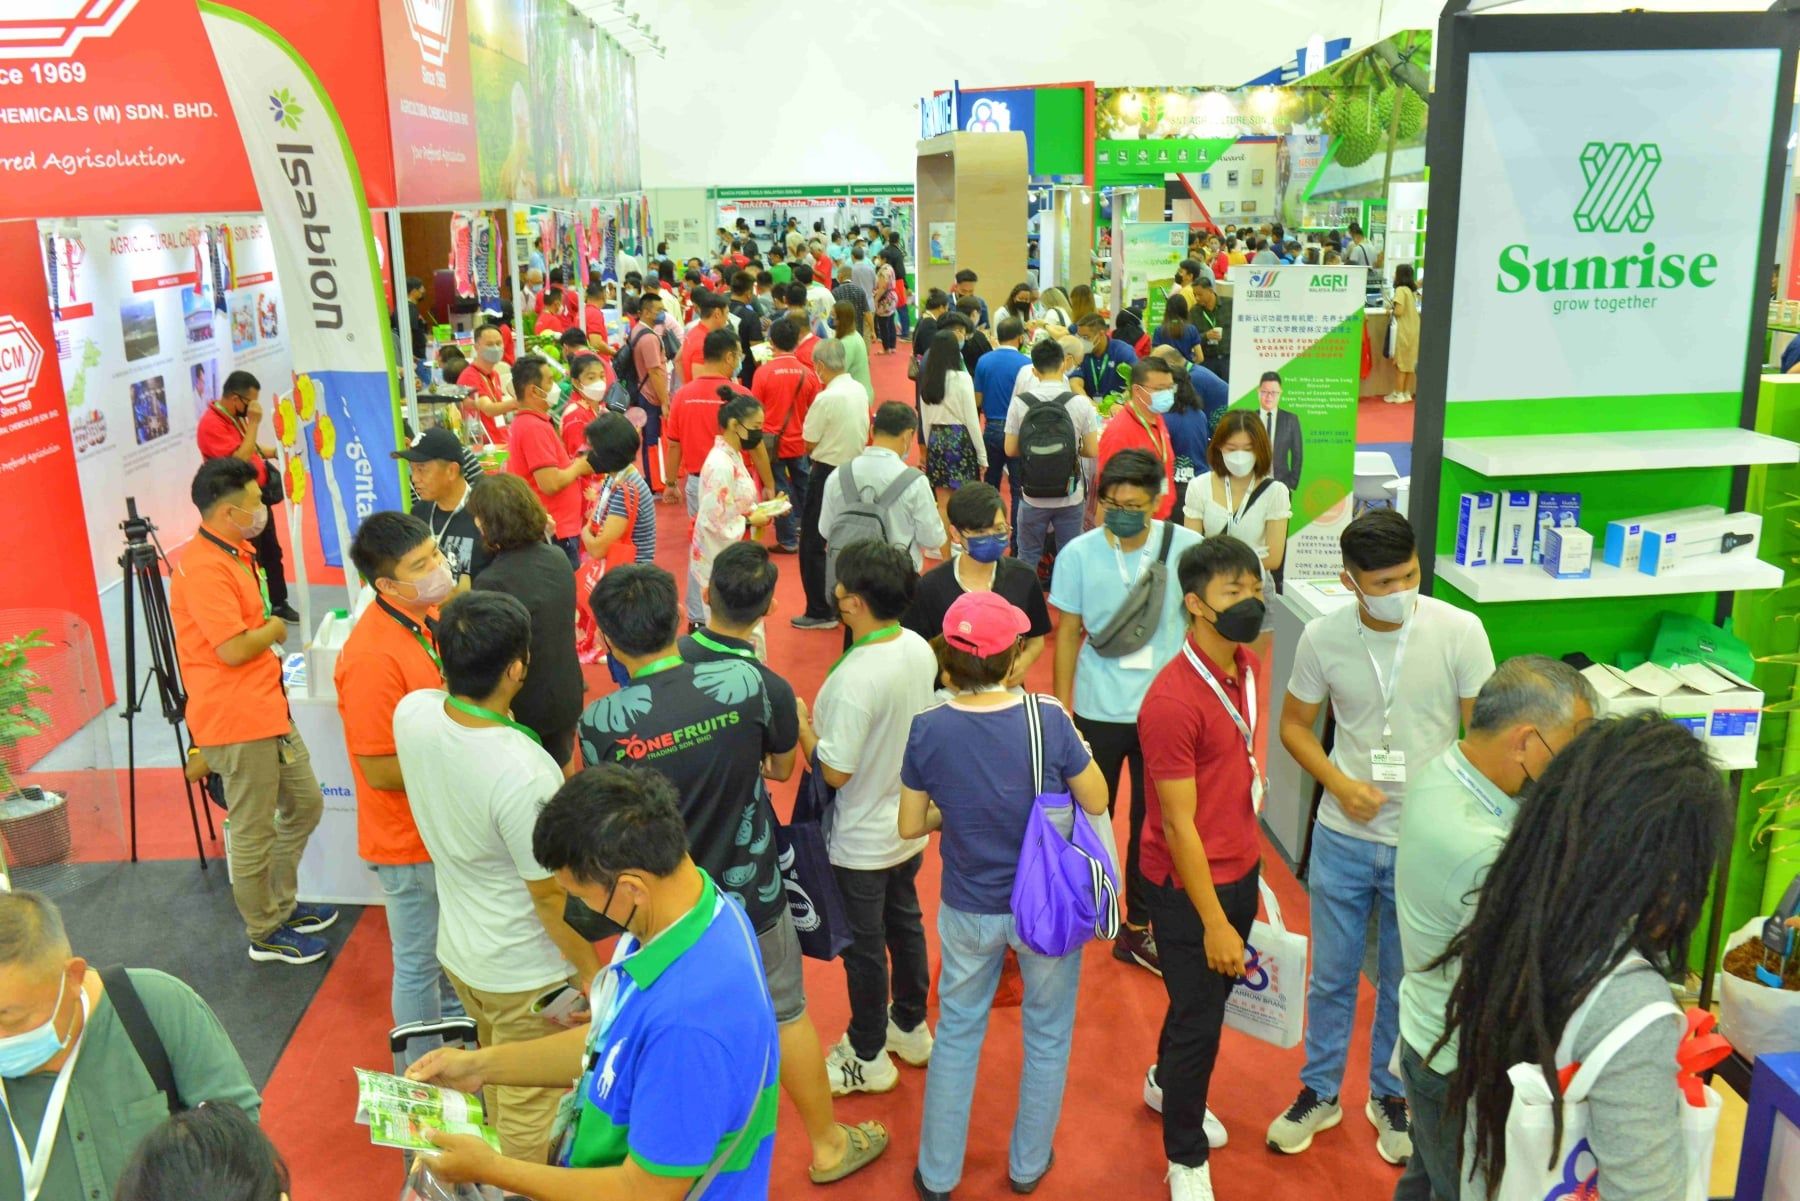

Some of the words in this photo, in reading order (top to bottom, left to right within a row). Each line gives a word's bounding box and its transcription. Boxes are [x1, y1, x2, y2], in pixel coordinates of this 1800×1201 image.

[30, 62, 87, 84] 1969
[93, 105, 121, 124] (M)
[126, 104, 169, 120] SDN.
[173, 102, 218, 119] BHD.
[42, 145, 186, 175] Agrisolution
[276, 143, 343, 330] Isabion
[1497, 242, 1718, 293] Sunrise
[1310, 274, 1348, 289] AGRI
[1553, 299, 1590, 315] grow
[1594, 295, 1658, 313] together
[0, 345, 26, 372] CM
[647, 745, 678, 760] TRADING
[1234, 988, 1261, 1001] ARROW
